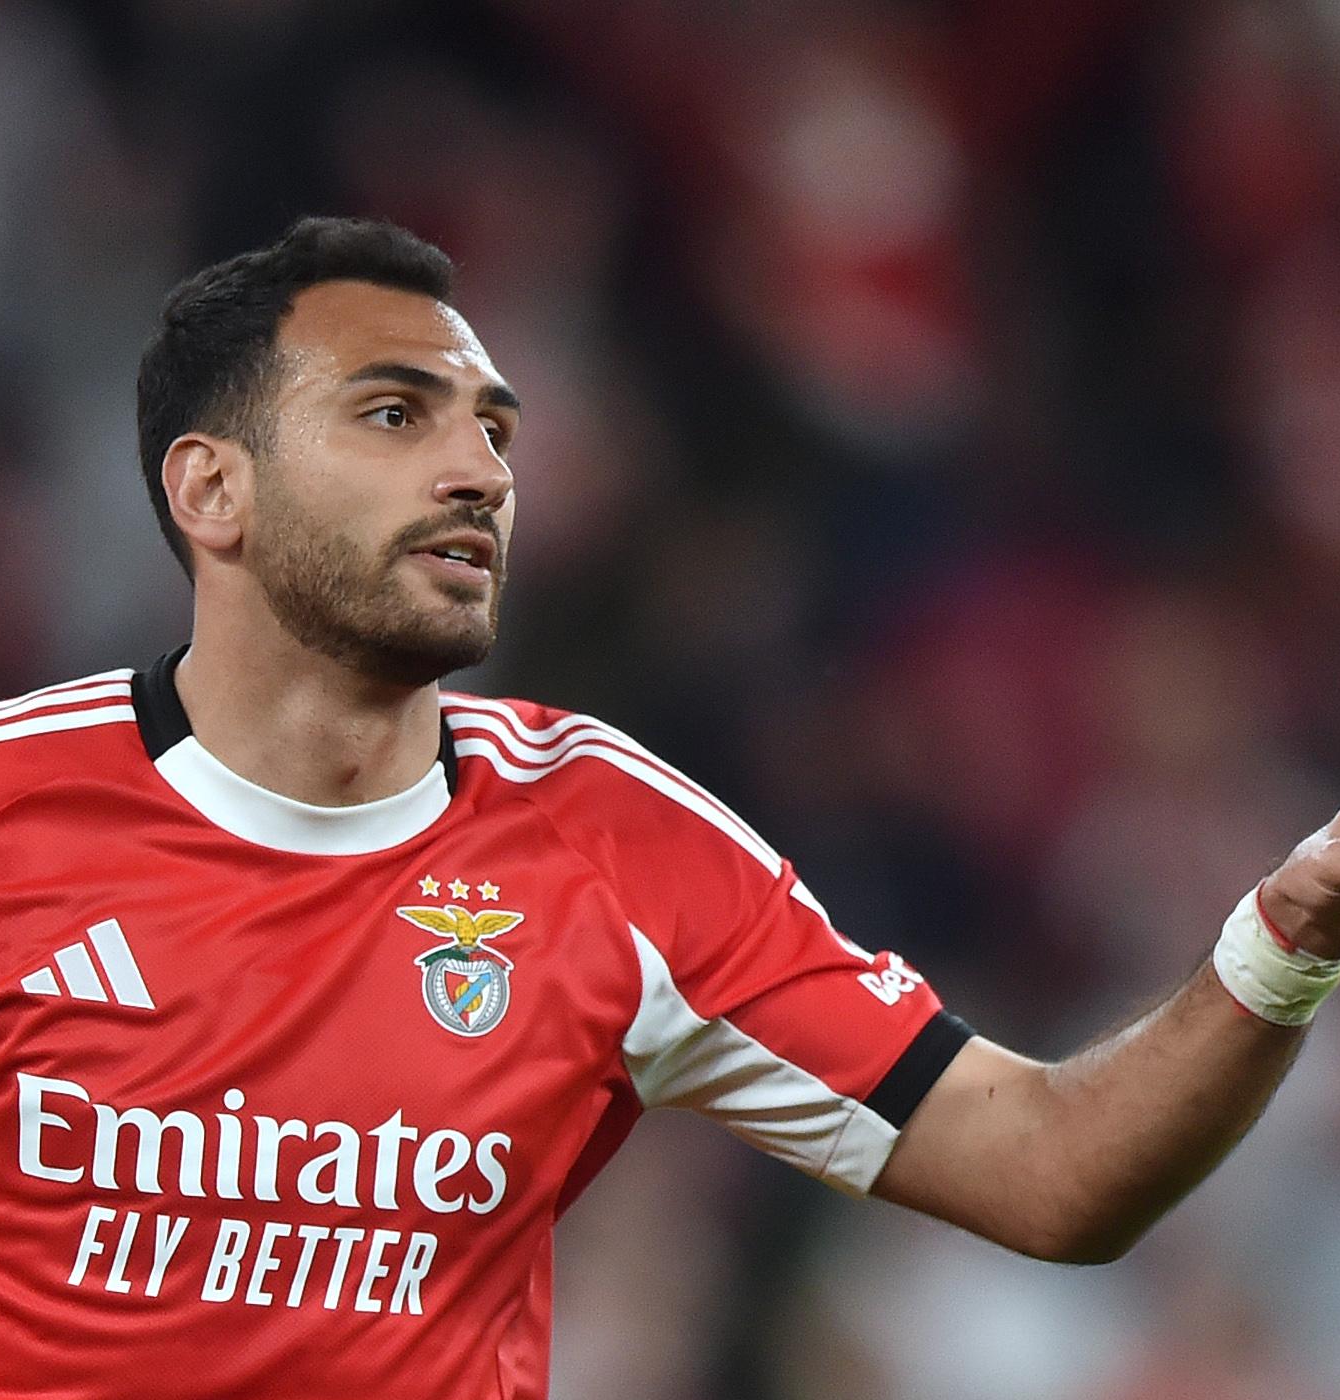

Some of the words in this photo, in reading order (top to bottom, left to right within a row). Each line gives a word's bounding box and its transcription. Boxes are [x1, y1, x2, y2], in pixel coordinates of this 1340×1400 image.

[16, 1072, 512, 1214] Emirates
[67, 1205, 190, 1298] FLY
[200, 1218, 438, 1315] BETTER
